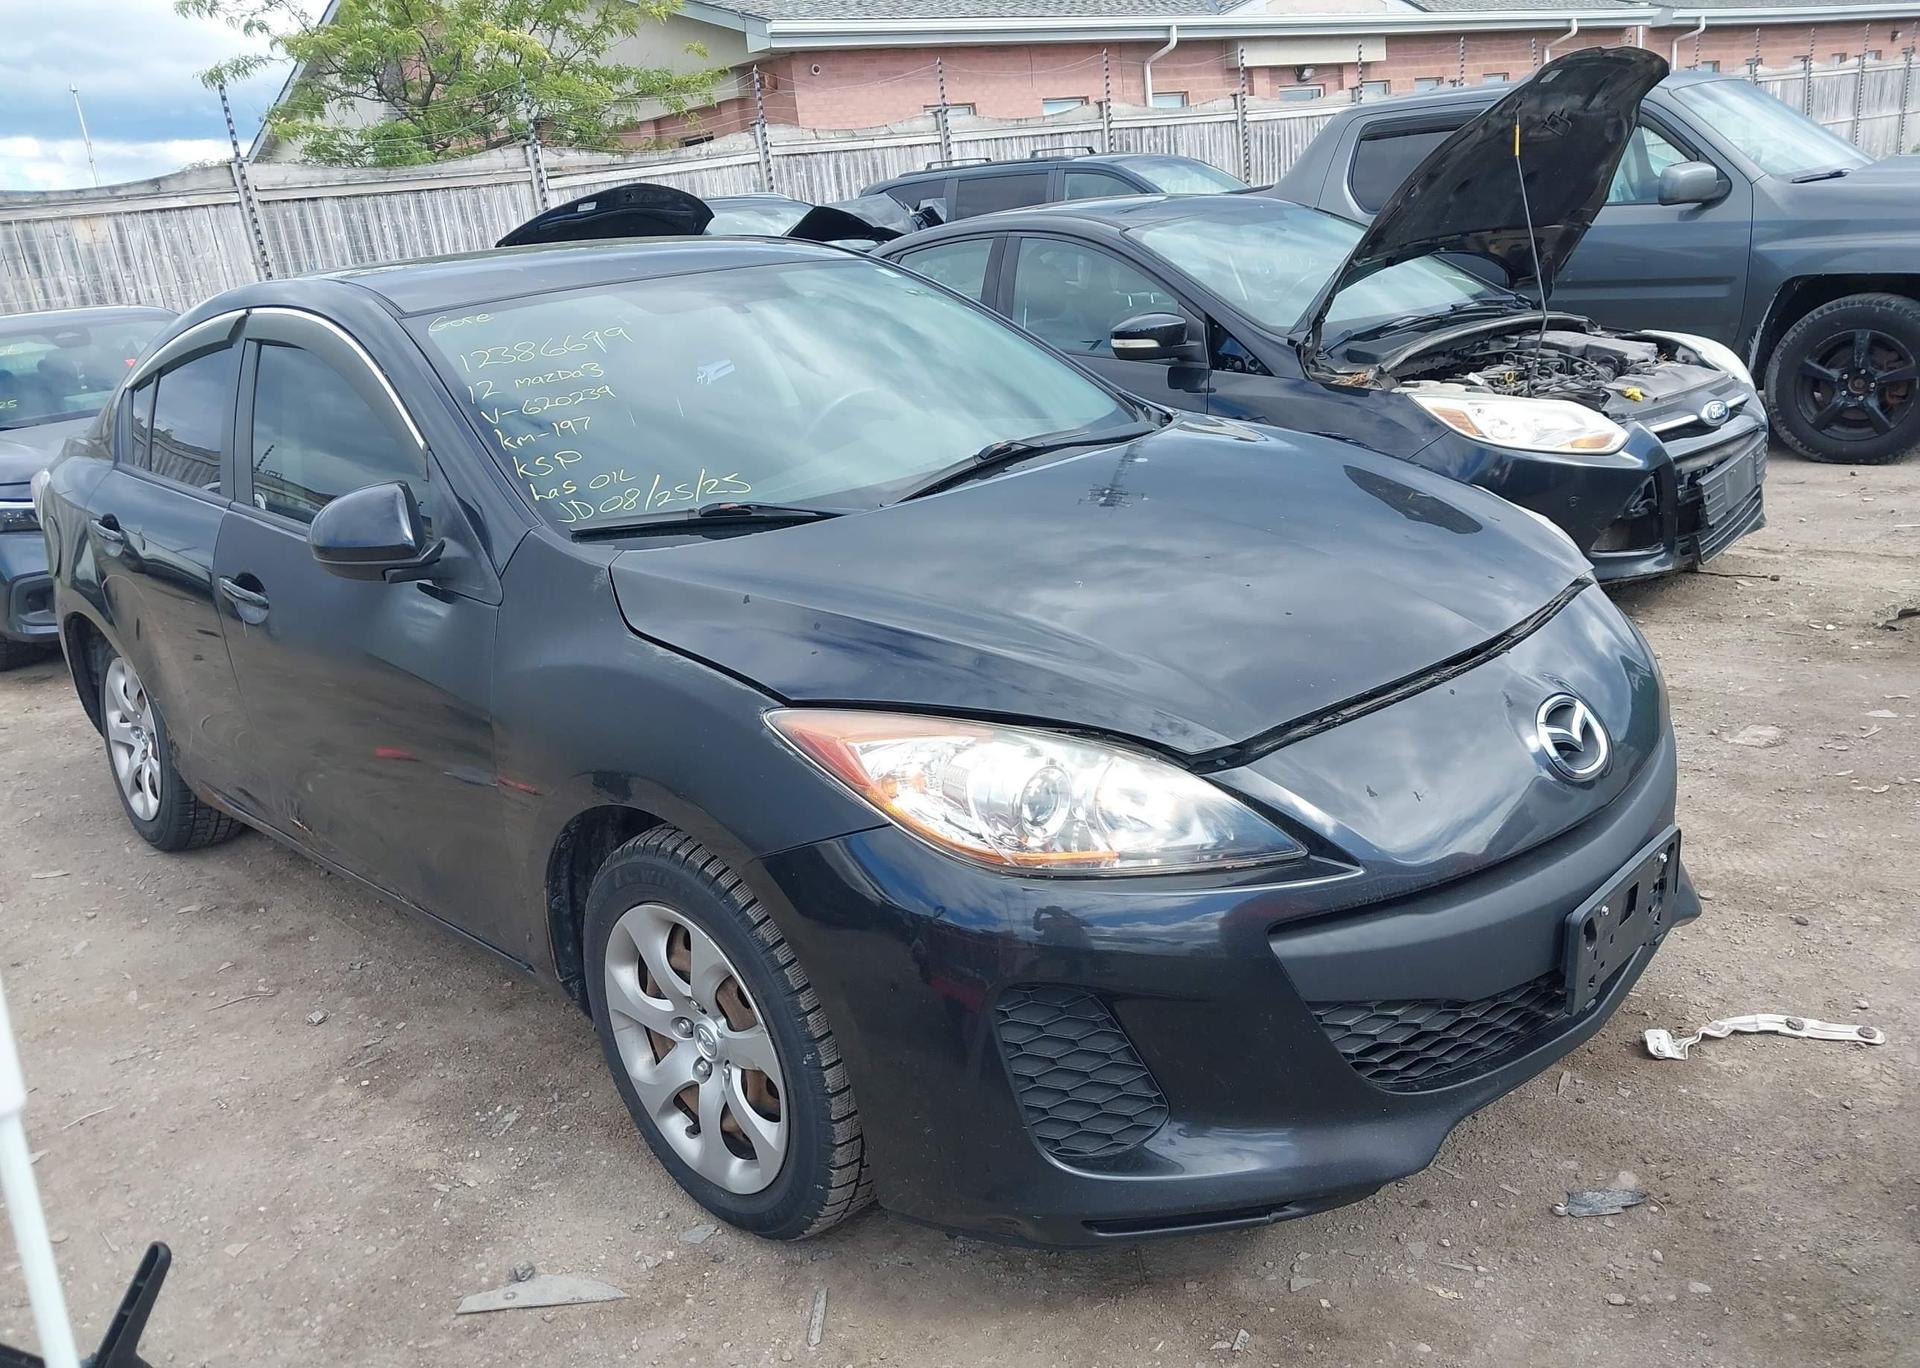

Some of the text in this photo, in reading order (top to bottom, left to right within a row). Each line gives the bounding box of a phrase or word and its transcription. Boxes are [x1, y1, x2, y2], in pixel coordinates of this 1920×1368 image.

[459, 326, 633, 373] 12386699
[467, 380, 501, 405] 12
[557, 468, 752, 523] JD 08/25/25
